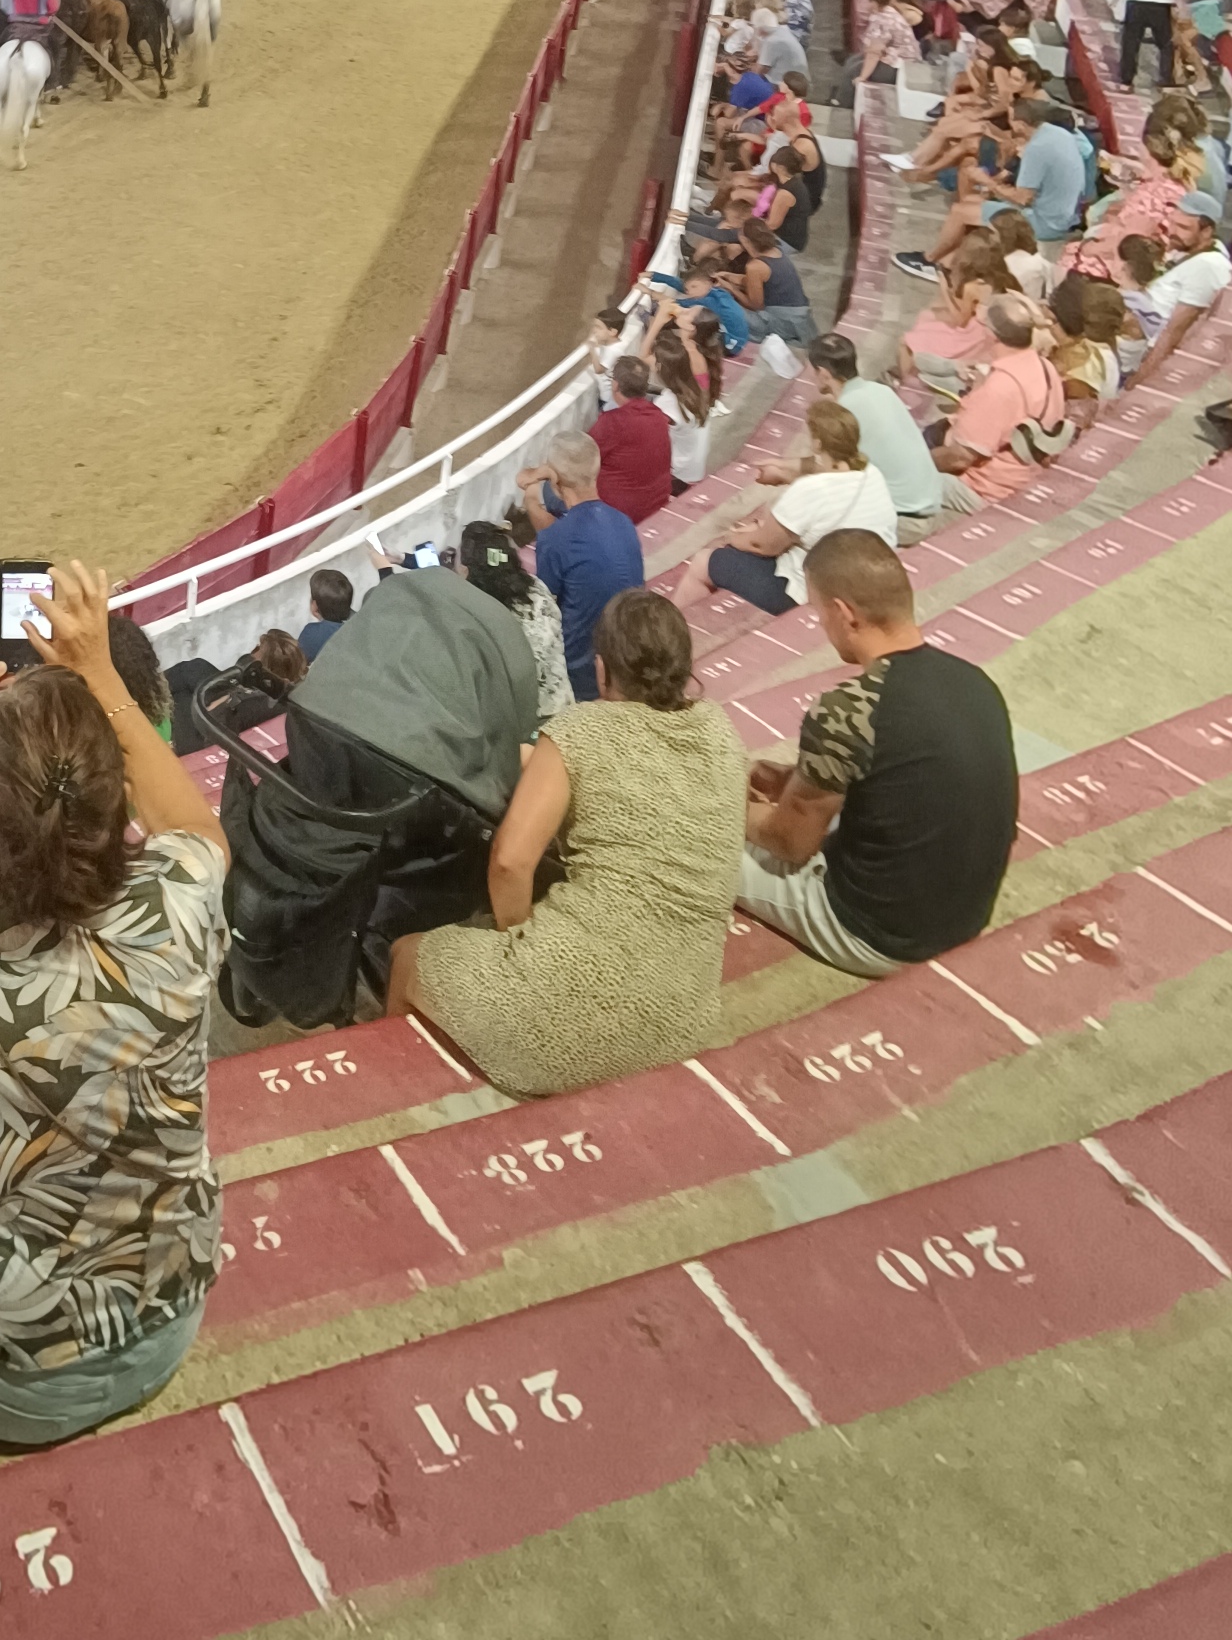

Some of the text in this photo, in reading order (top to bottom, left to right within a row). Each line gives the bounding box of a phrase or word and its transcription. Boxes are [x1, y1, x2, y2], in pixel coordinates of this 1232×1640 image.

[1196, 717, 1232, 747] 17
[1042, 774, 1108, 806] 218
[258, 1050, 358, 1095] 222
[802, 1030, 905, 1084] 229
[482, 1130, 604, 1186] 228
[875, 1225, 1026, 1292] 290
[413, 1368, 583, 1457] 291
